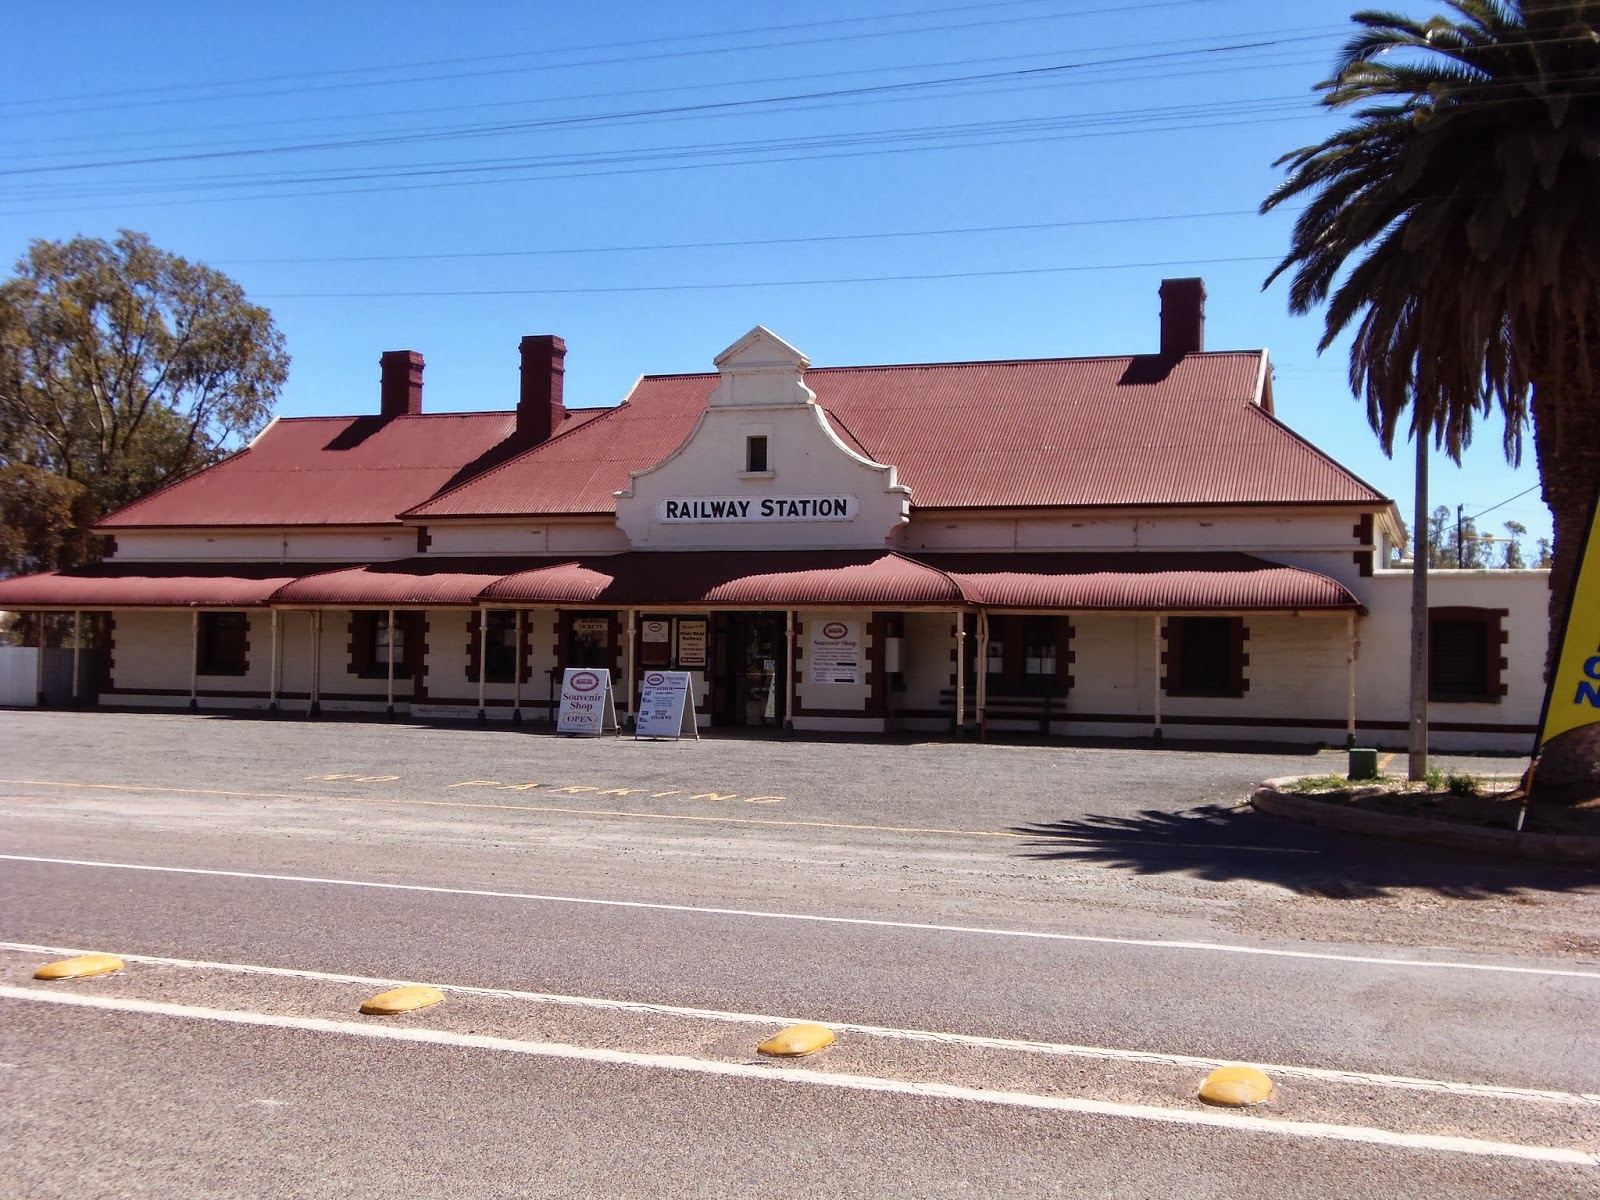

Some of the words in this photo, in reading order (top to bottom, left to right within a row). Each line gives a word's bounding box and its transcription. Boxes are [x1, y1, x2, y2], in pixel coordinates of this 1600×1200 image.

[666, 500, 750, 519] RAILWAY
[760, 498, 847, 517] STATION
[562, 693, 602, 702] Souvenir
[570, 702, 593, 711] Shop
[567, 715, 593, 723] OPEN
[447, 780, 787, 803] PARKING
